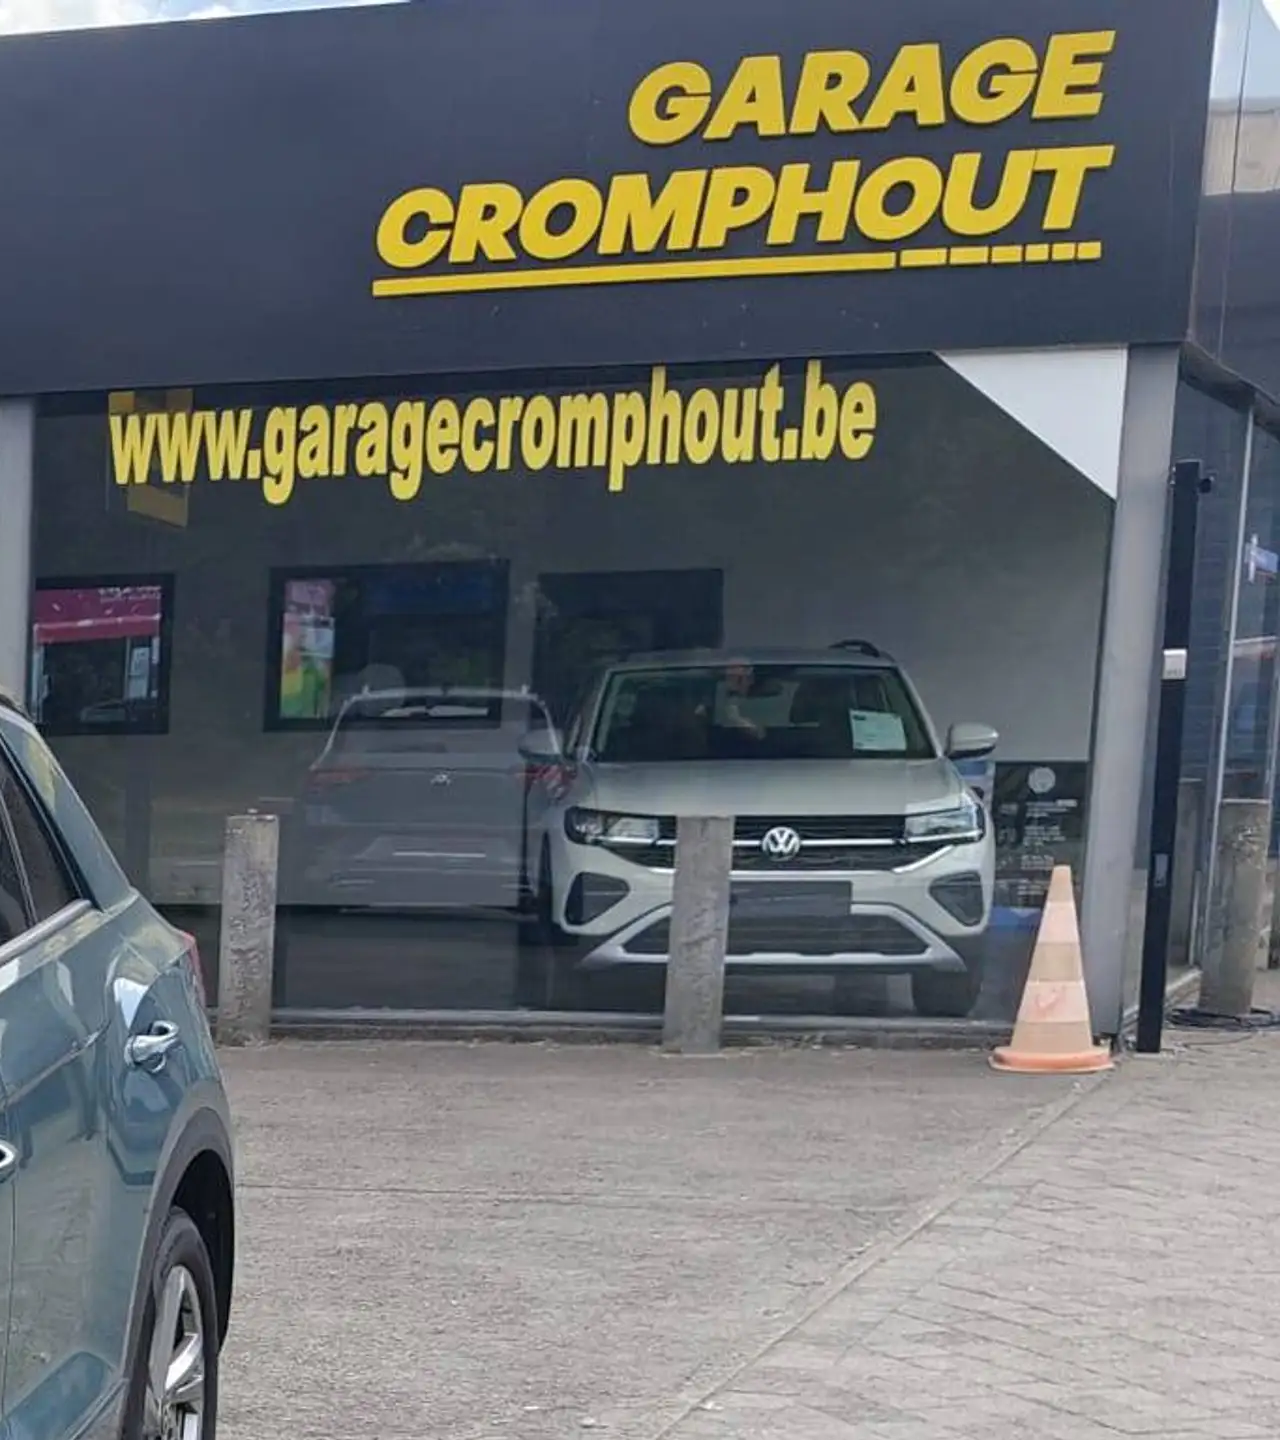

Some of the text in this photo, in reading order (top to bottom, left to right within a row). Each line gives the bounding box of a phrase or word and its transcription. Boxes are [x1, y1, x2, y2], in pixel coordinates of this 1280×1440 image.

[628, 30, 1116, 145] GARAGE
[374, 144, 1115, 268] CROMPHOUT
[108, 362, 875, 506] www.garagecromphout.be
